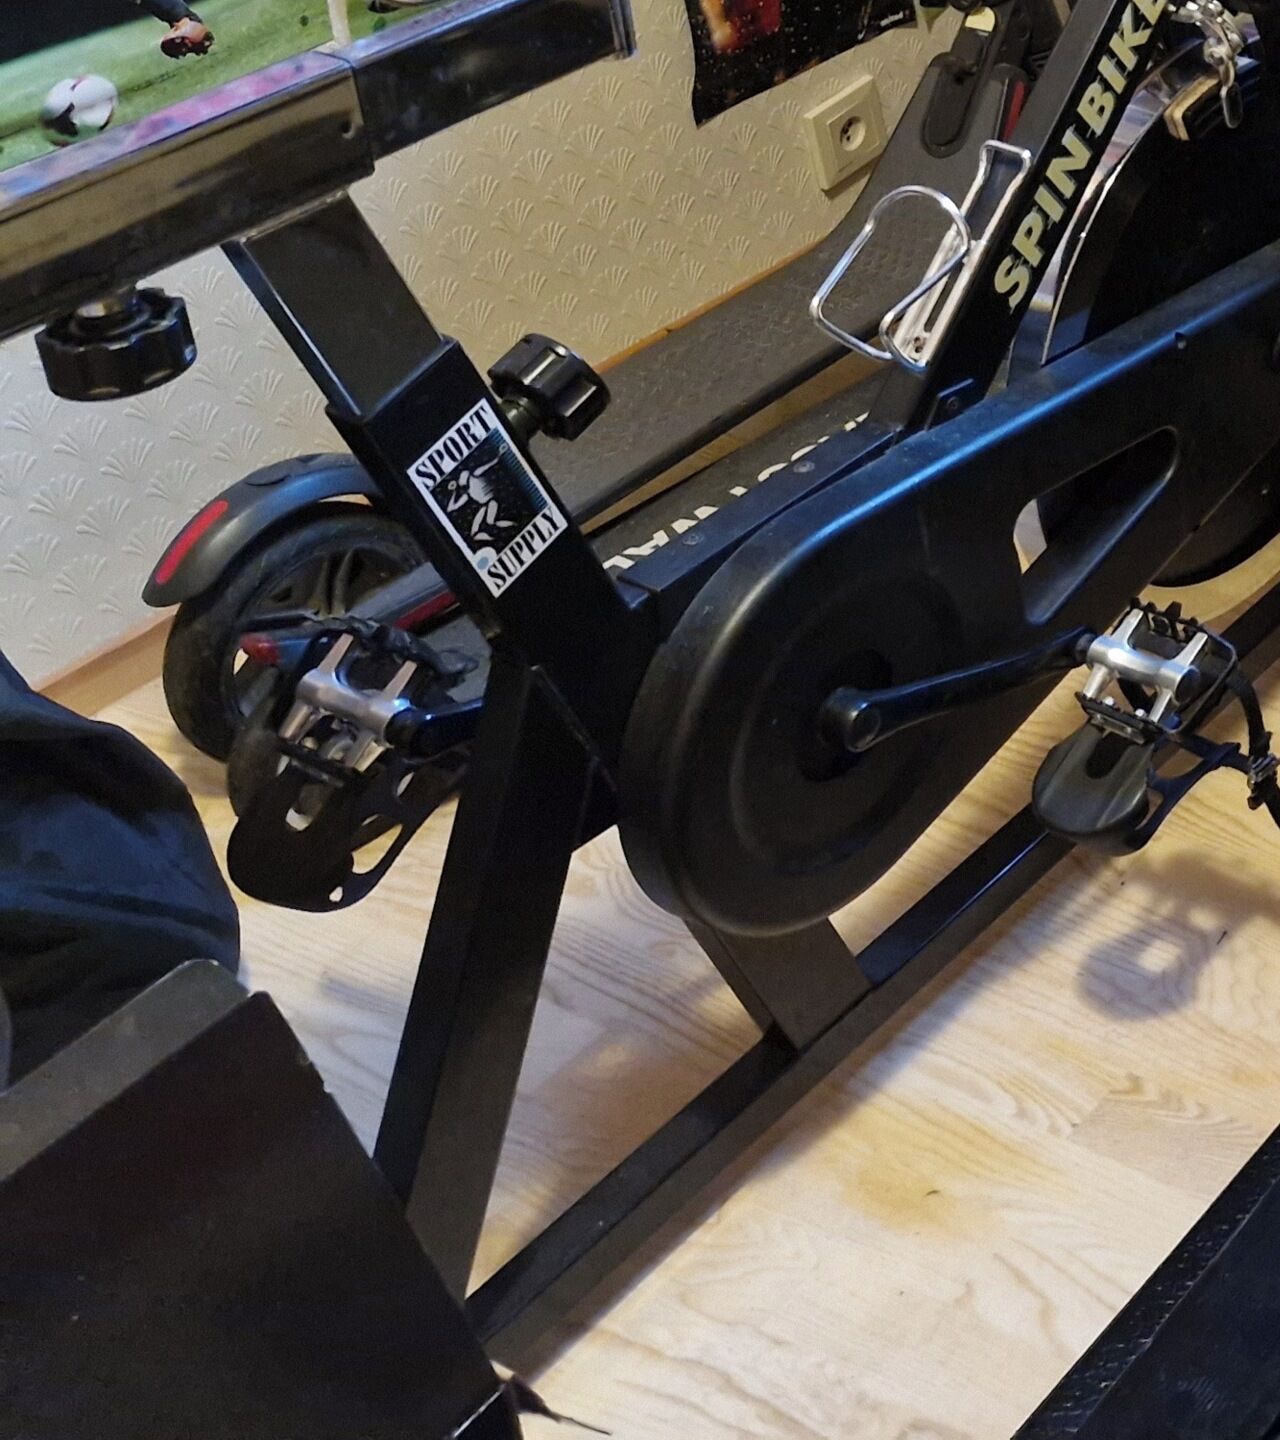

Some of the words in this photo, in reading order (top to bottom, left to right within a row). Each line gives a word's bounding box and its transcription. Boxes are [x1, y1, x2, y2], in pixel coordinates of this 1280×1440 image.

[993, 124, 1093, 314] SPIN
[413, 406, 496, 491] SPORT
[486, 506, 566, 591] SUPPLY
